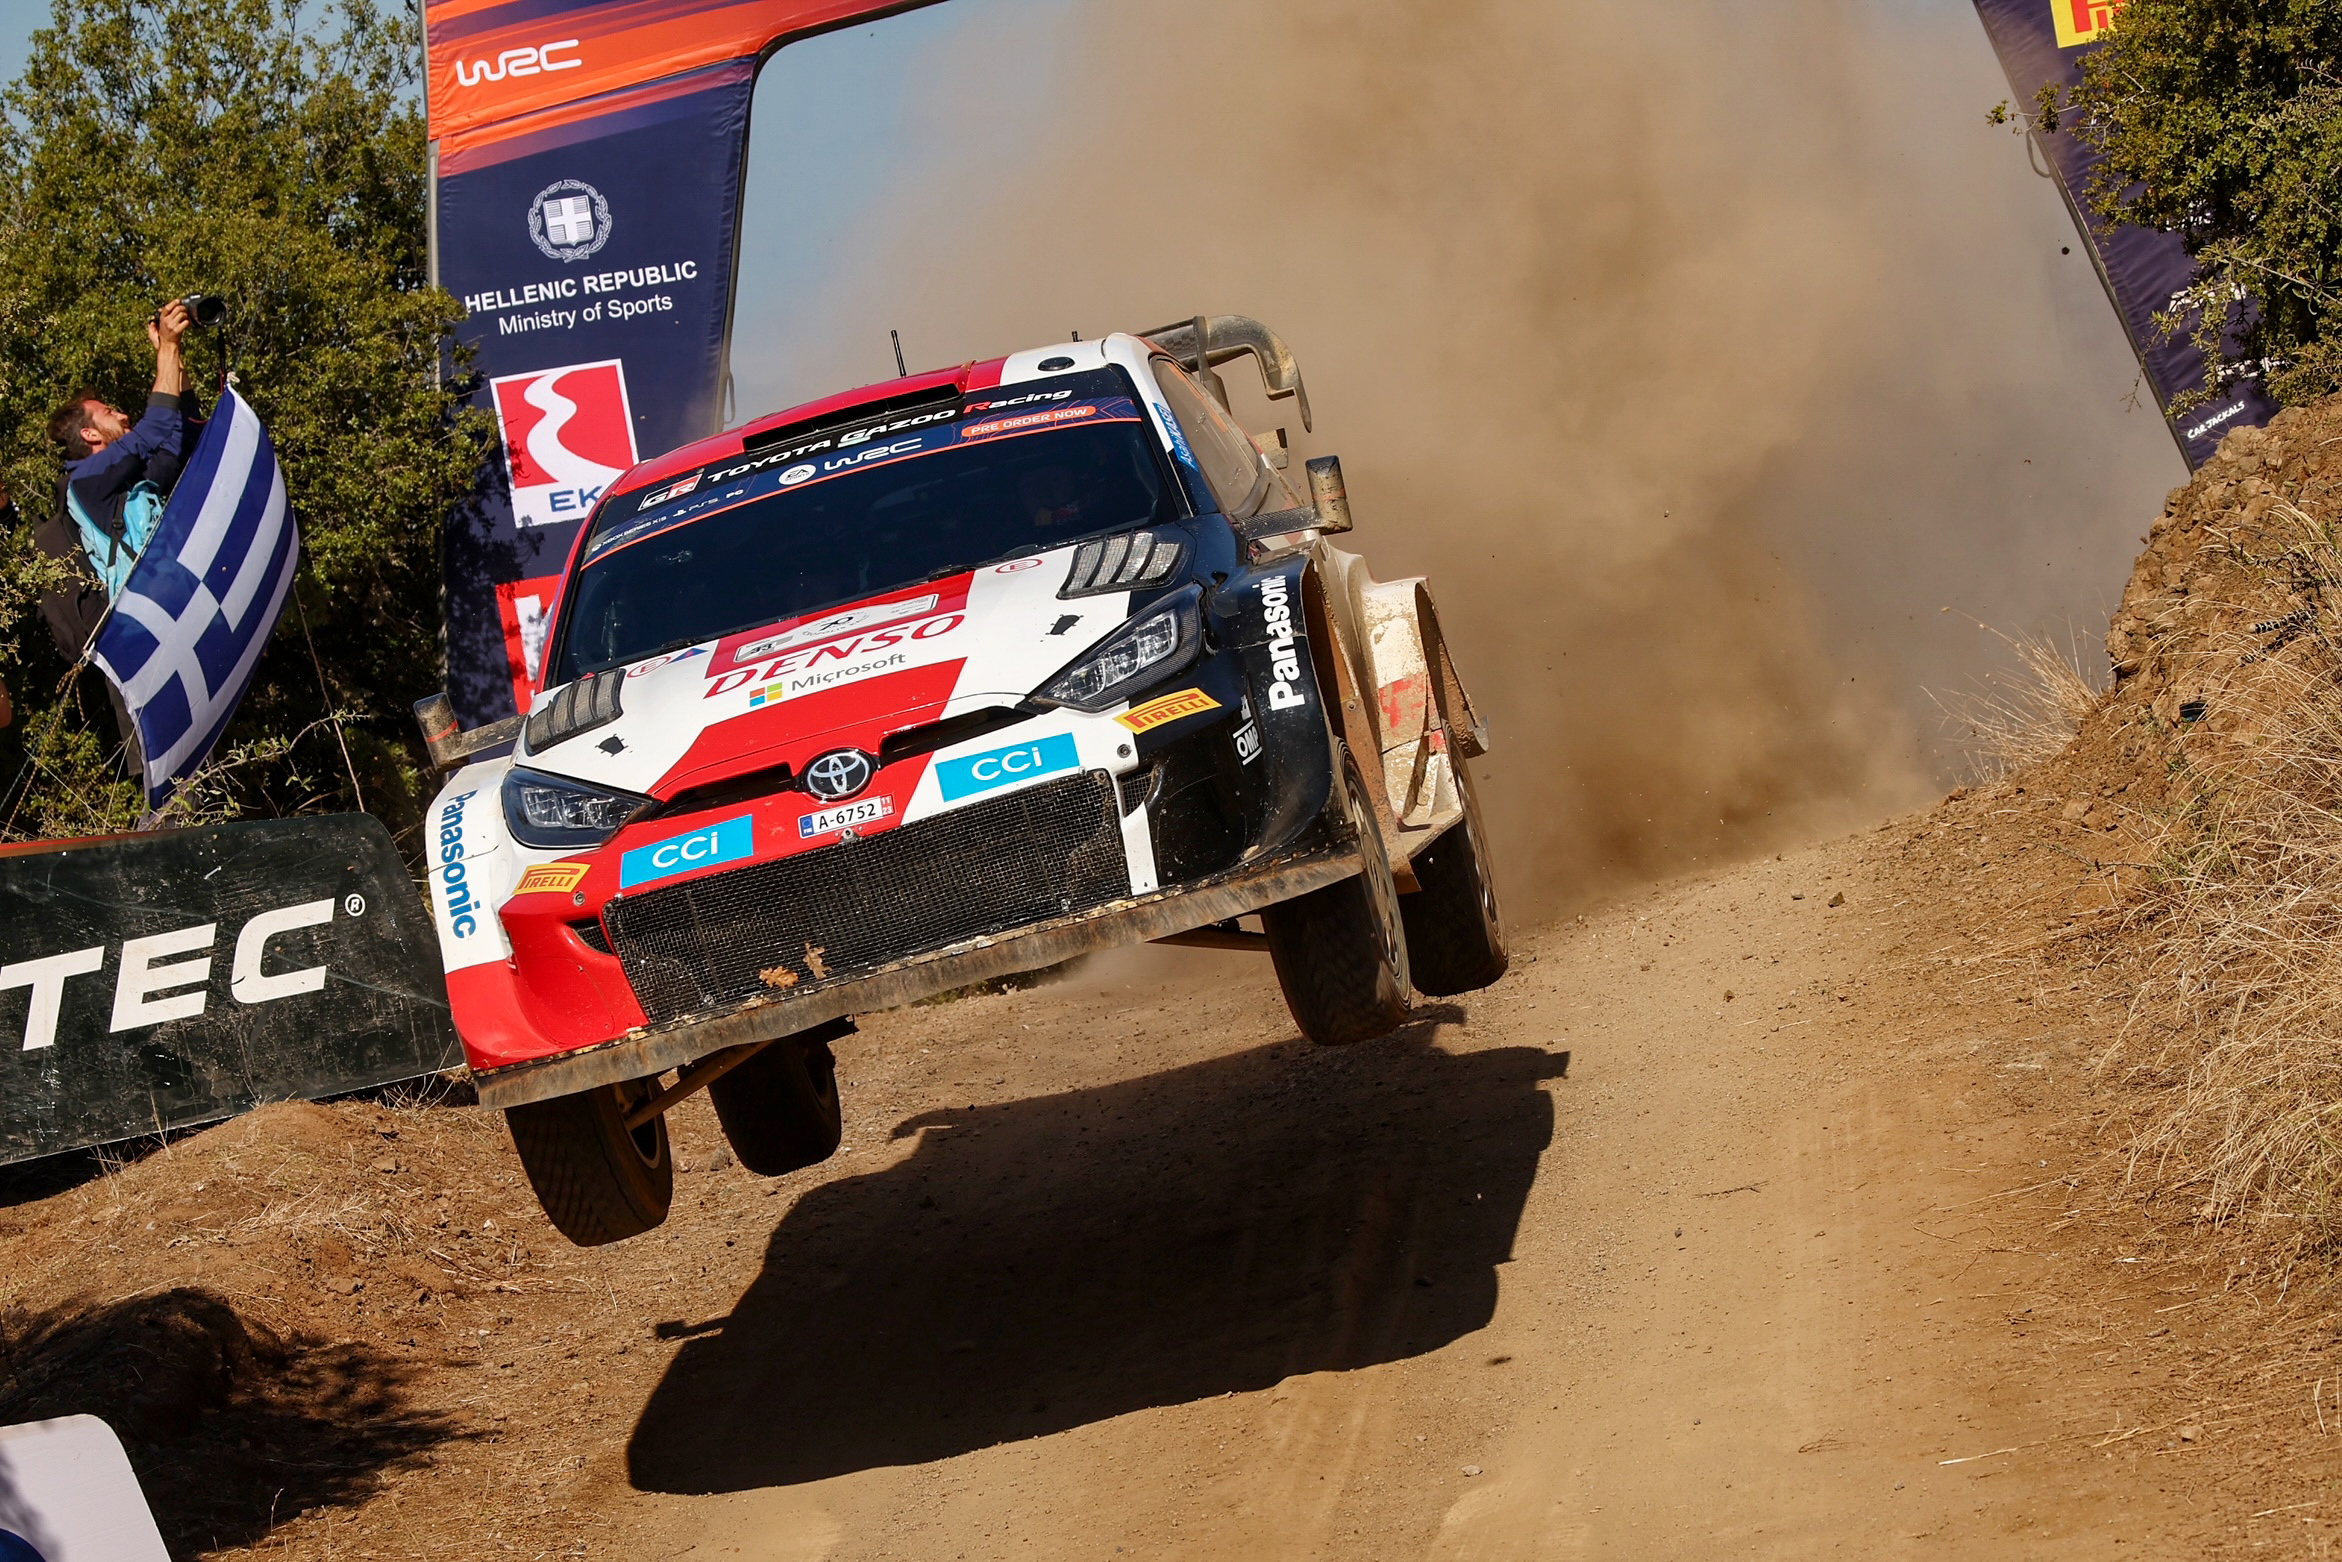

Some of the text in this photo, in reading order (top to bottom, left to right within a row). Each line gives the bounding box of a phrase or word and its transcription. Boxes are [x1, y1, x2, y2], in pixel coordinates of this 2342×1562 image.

[455, 38, 583, 87] WRC
[464, 260, 698, 314] HELLENIC REPUBLIC
[498, 293, 673, 336] Ministry of Sports
[971, 408, 1088, 435] PRE ORDER NOW
[641, 389, 1073, 509] GR TOYOTA GAZOO Racing
[824, 437, 922, 472] WRC
[550, 485, 603, 512] EK
[703, 614, 965, 700] DENSO
[1252, 575, 1305, 711] Panasonic
[791, 652, 906, 692] Microsoft
[1123, 693, 1211, 729] PIRELLI
[1236, 725, 1260, 758] OMP
[818, 803, 876, 830] A-6752
[440, 788, 481, 940] Panasonic
[518, 867, 580, 891] PIRELLI
[0, 897, 335, 1052] TEC
